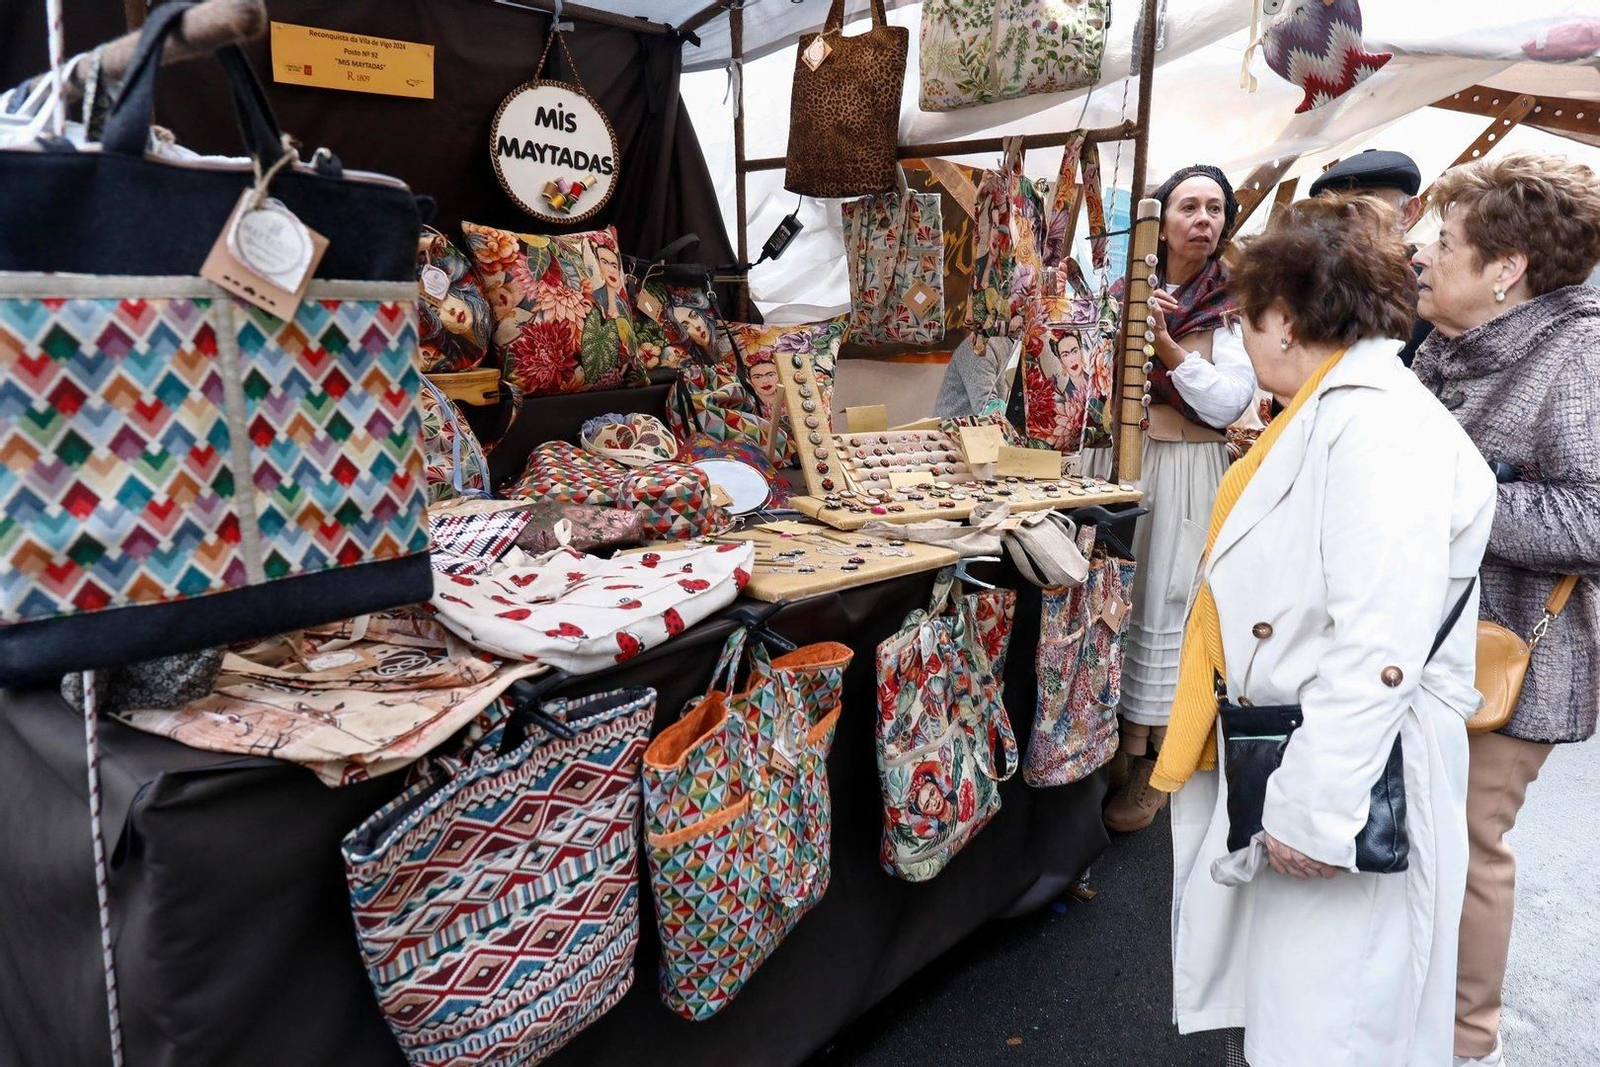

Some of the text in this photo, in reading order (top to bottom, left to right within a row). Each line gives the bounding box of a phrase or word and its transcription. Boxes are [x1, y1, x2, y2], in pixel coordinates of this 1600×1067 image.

[309, 29, 349, 41] Reconquista
[359, 37, 371, 45] Vila
[380, 41, 392, 49] Vigo
[393, 42, 406, 50] 2024
[343, 48, 361, 57] Posto
[371, 51, 379, 59] 92
[347, 70, 355, 81] R
[498, 135, 614, 175] MAYTADAS
